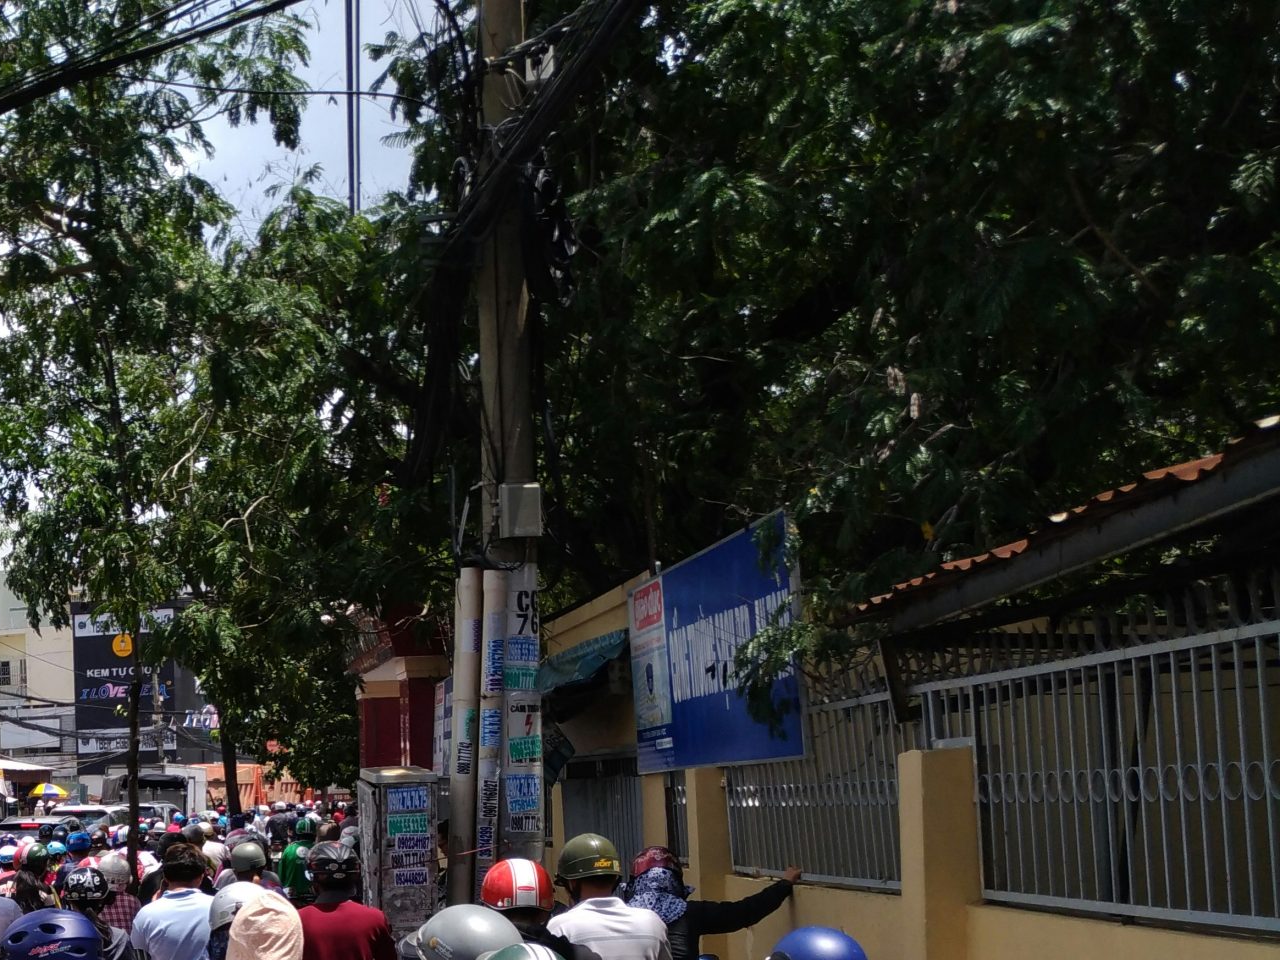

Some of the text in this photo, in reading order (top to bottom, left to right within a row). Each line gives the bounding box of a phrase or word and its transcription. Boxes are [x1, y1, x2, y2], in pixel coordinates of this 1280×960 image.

[516, 613, 539, 635] 76
[86, 668, 110, 678] KEM
[112, 667, 127, 679] TỰ
